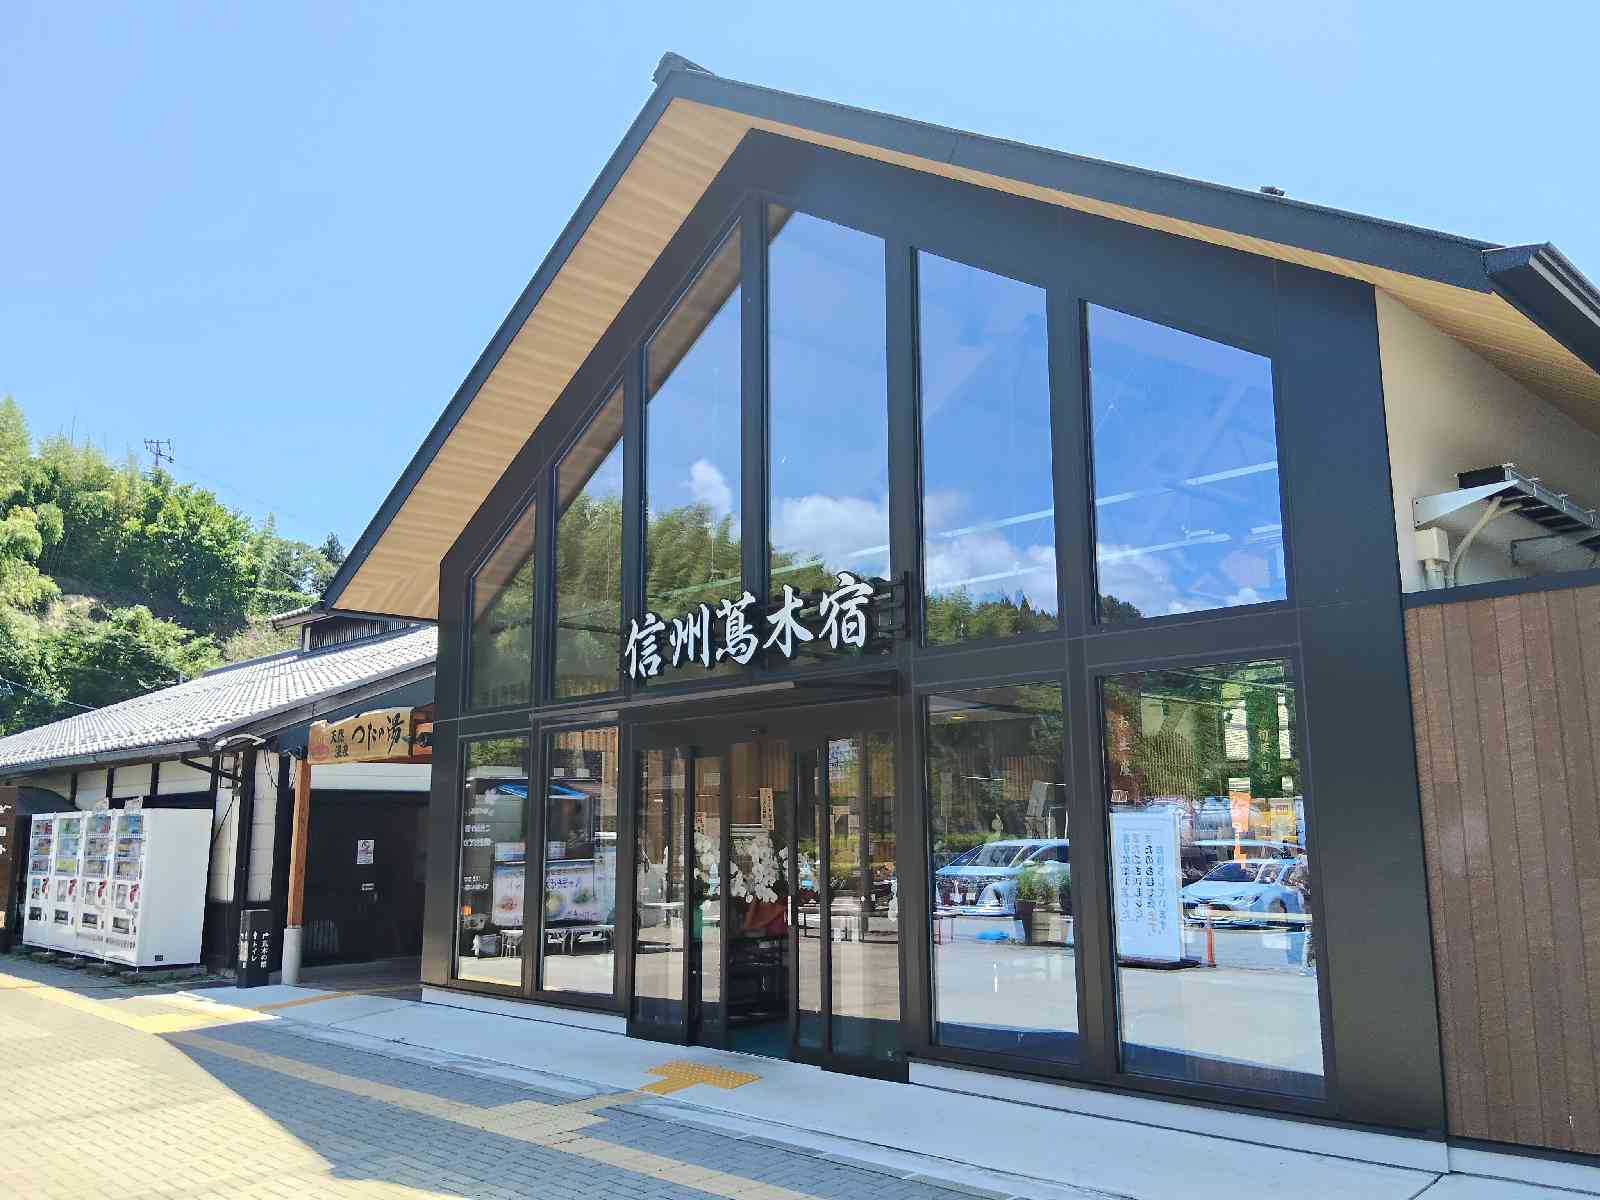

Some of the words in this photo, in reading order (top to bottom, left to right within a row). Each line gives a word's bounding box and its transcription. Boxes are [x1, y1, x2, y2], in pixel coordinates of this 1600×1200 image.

[624, 571, 875, 680] 信州蔦木宿
[351, 712, 405, 755] つたの湯
